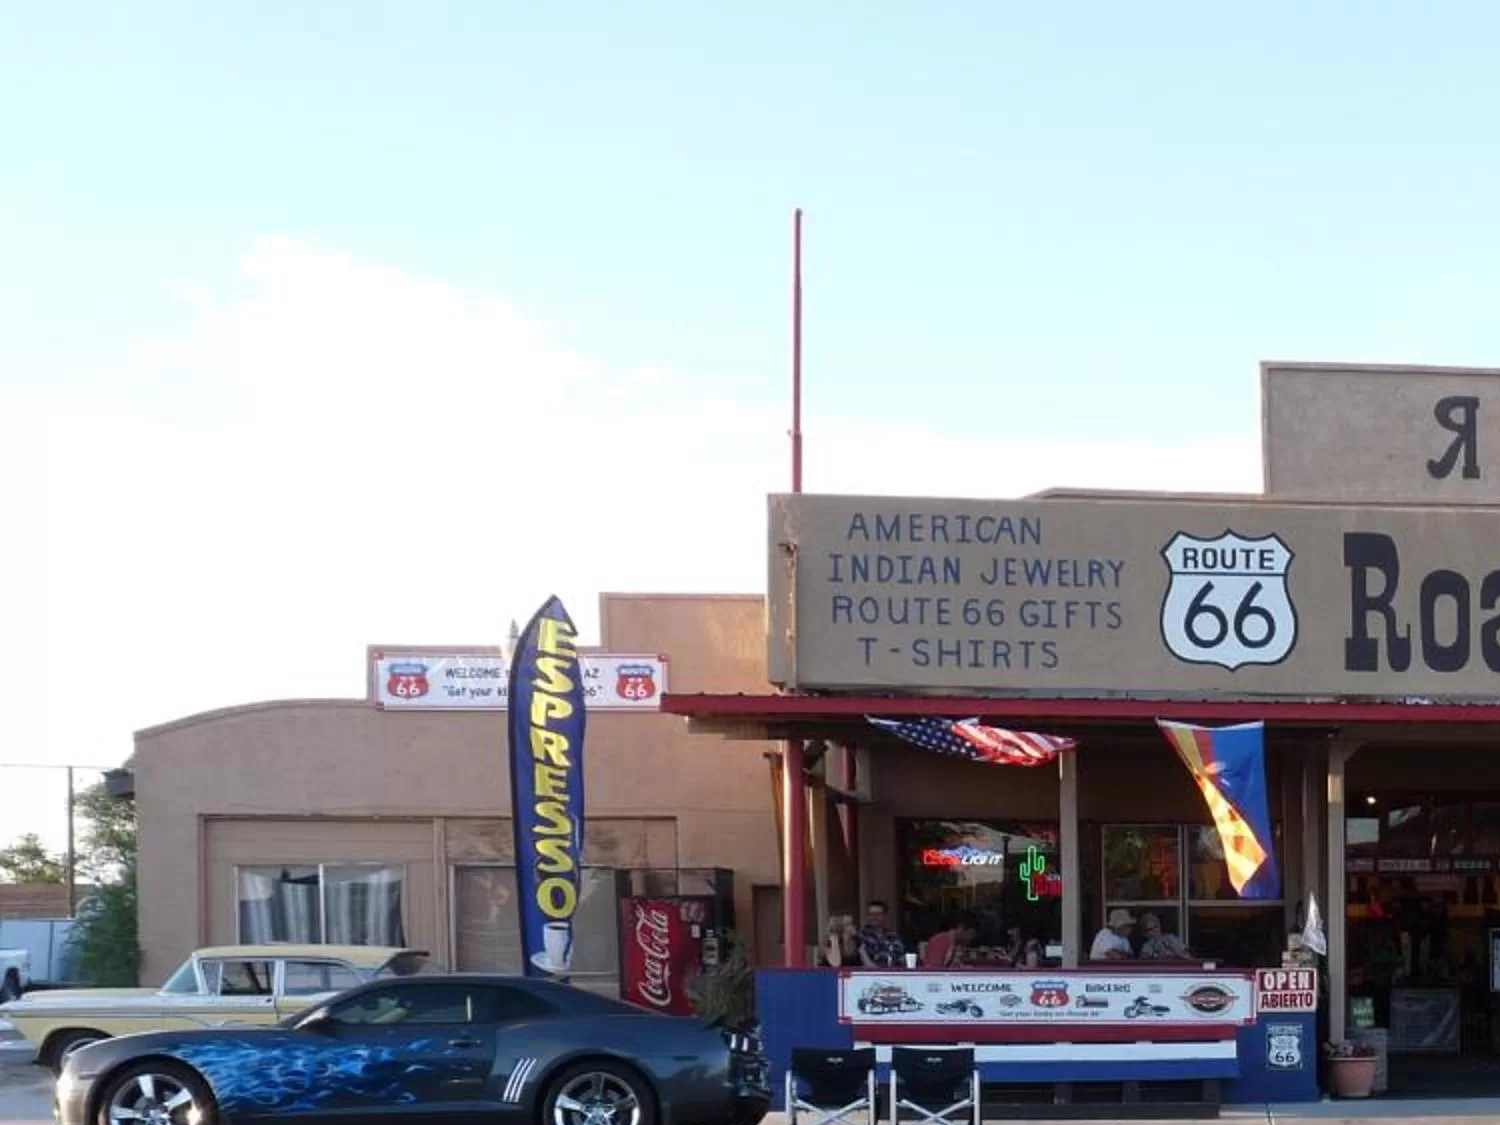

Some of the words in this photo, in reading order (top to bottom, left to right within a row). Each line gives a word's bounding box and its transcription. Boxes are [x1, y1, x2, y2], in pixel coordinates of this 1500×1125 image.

[848, 512, 1042, 544] AMERICAN
[1182, 547, 1275, 571] ROUTE
[827, 553, 961, 586] INDIAN
[980, 557, 1125, 589] JEWELRY
[831, 596, 950, 625] ROUTE
[962, 598, 1005, 627] 66
[1019, 600, 1124, 631] GIFTS
[1184, 581, 1276, 649] 66
[445, 668, 501, 678] WELCOME
[396, 680, 421, 696] 66
[624, 682, 648, 697] 66
[530, 619, 577, 921] ESPRESSO
[951, 983, 1012, 993] WELCOME
[1263, 971, 1310, 990] OPEN
[1038, 993, 1062, 1006] 66
[1261, 992, 1313, 1009] ABIERTO
[1275, 1051, 1295, 1063] 66
